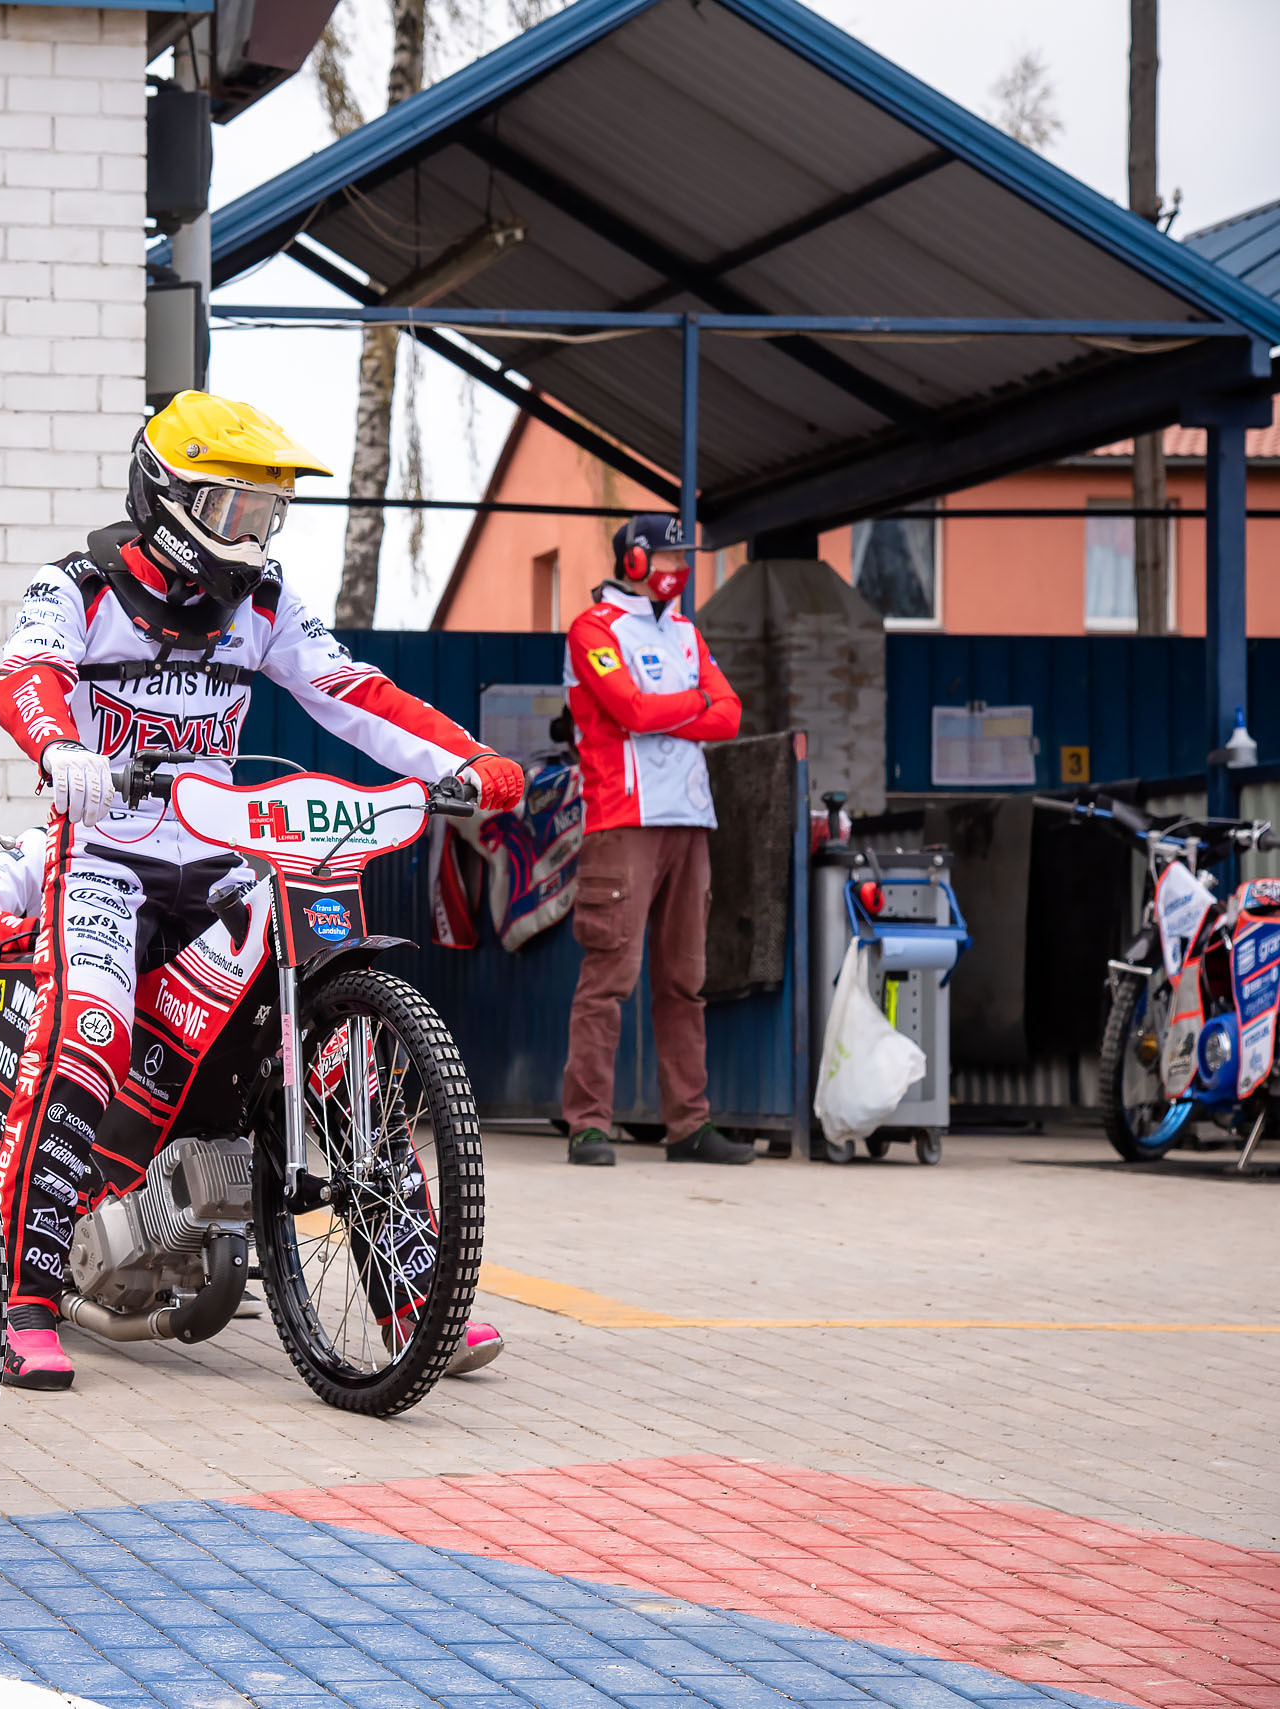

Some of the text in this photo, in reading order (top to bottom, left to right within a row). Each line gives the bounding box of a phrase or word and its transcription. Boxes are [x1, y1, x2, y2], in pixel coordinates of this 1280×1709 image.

[1069, 752, 1083, 776] 3
[307, 800, 376, 835] BAU
[304, 908, 352, 931] DEVILS
[318, 928, 346, 936] Landshut
[155, 978, 186, 1027] Trans
[20, 1051, 41, 1096] MF
[40, 1214, 55, 1228] LAKE
